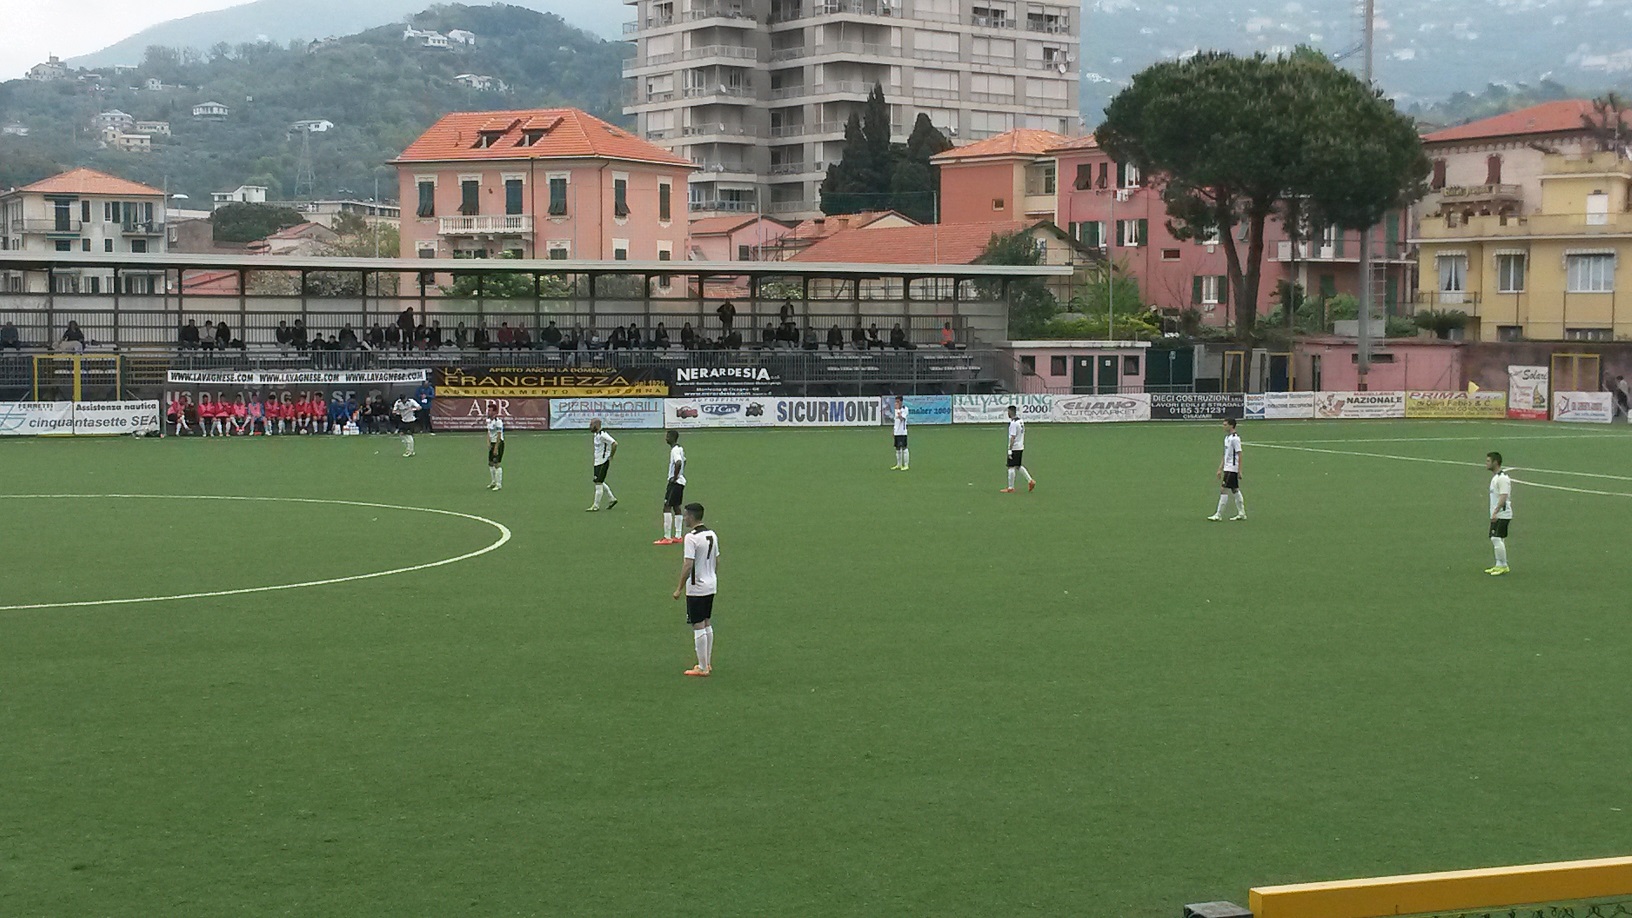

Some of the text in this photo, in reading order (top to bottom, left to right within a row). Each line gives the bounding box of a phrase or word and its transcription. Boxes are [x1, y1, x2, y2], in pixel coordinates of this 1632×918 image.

[444, 367, 465, 375] LA
[677, 368, 770, 381] NERARDESIA
[171, 371, 424, 382] WWW.LAVAGNESE.COM WWW.LAVAGNESE.COM WWW.LAVAGNESE.COM
[444, 376, 629, 386] FRANCHEZZA
[1152, 394, 1175, 402] DIECI
[1176, 394, 1230, 402] COSTRUZIONI
[1346, 396, 1403, 404] NAZIONALE
[76, 402, 157, 411] Assistenza nautica
[1022, 404, 1047, 413] 2000
[1063, 401, 1137, 410] ELIANO
[777, 400, 879, 422] SICURMONT
[28, 415, 158, 430] cinquantasette SEA
[706, 536, 714, 560] 7
